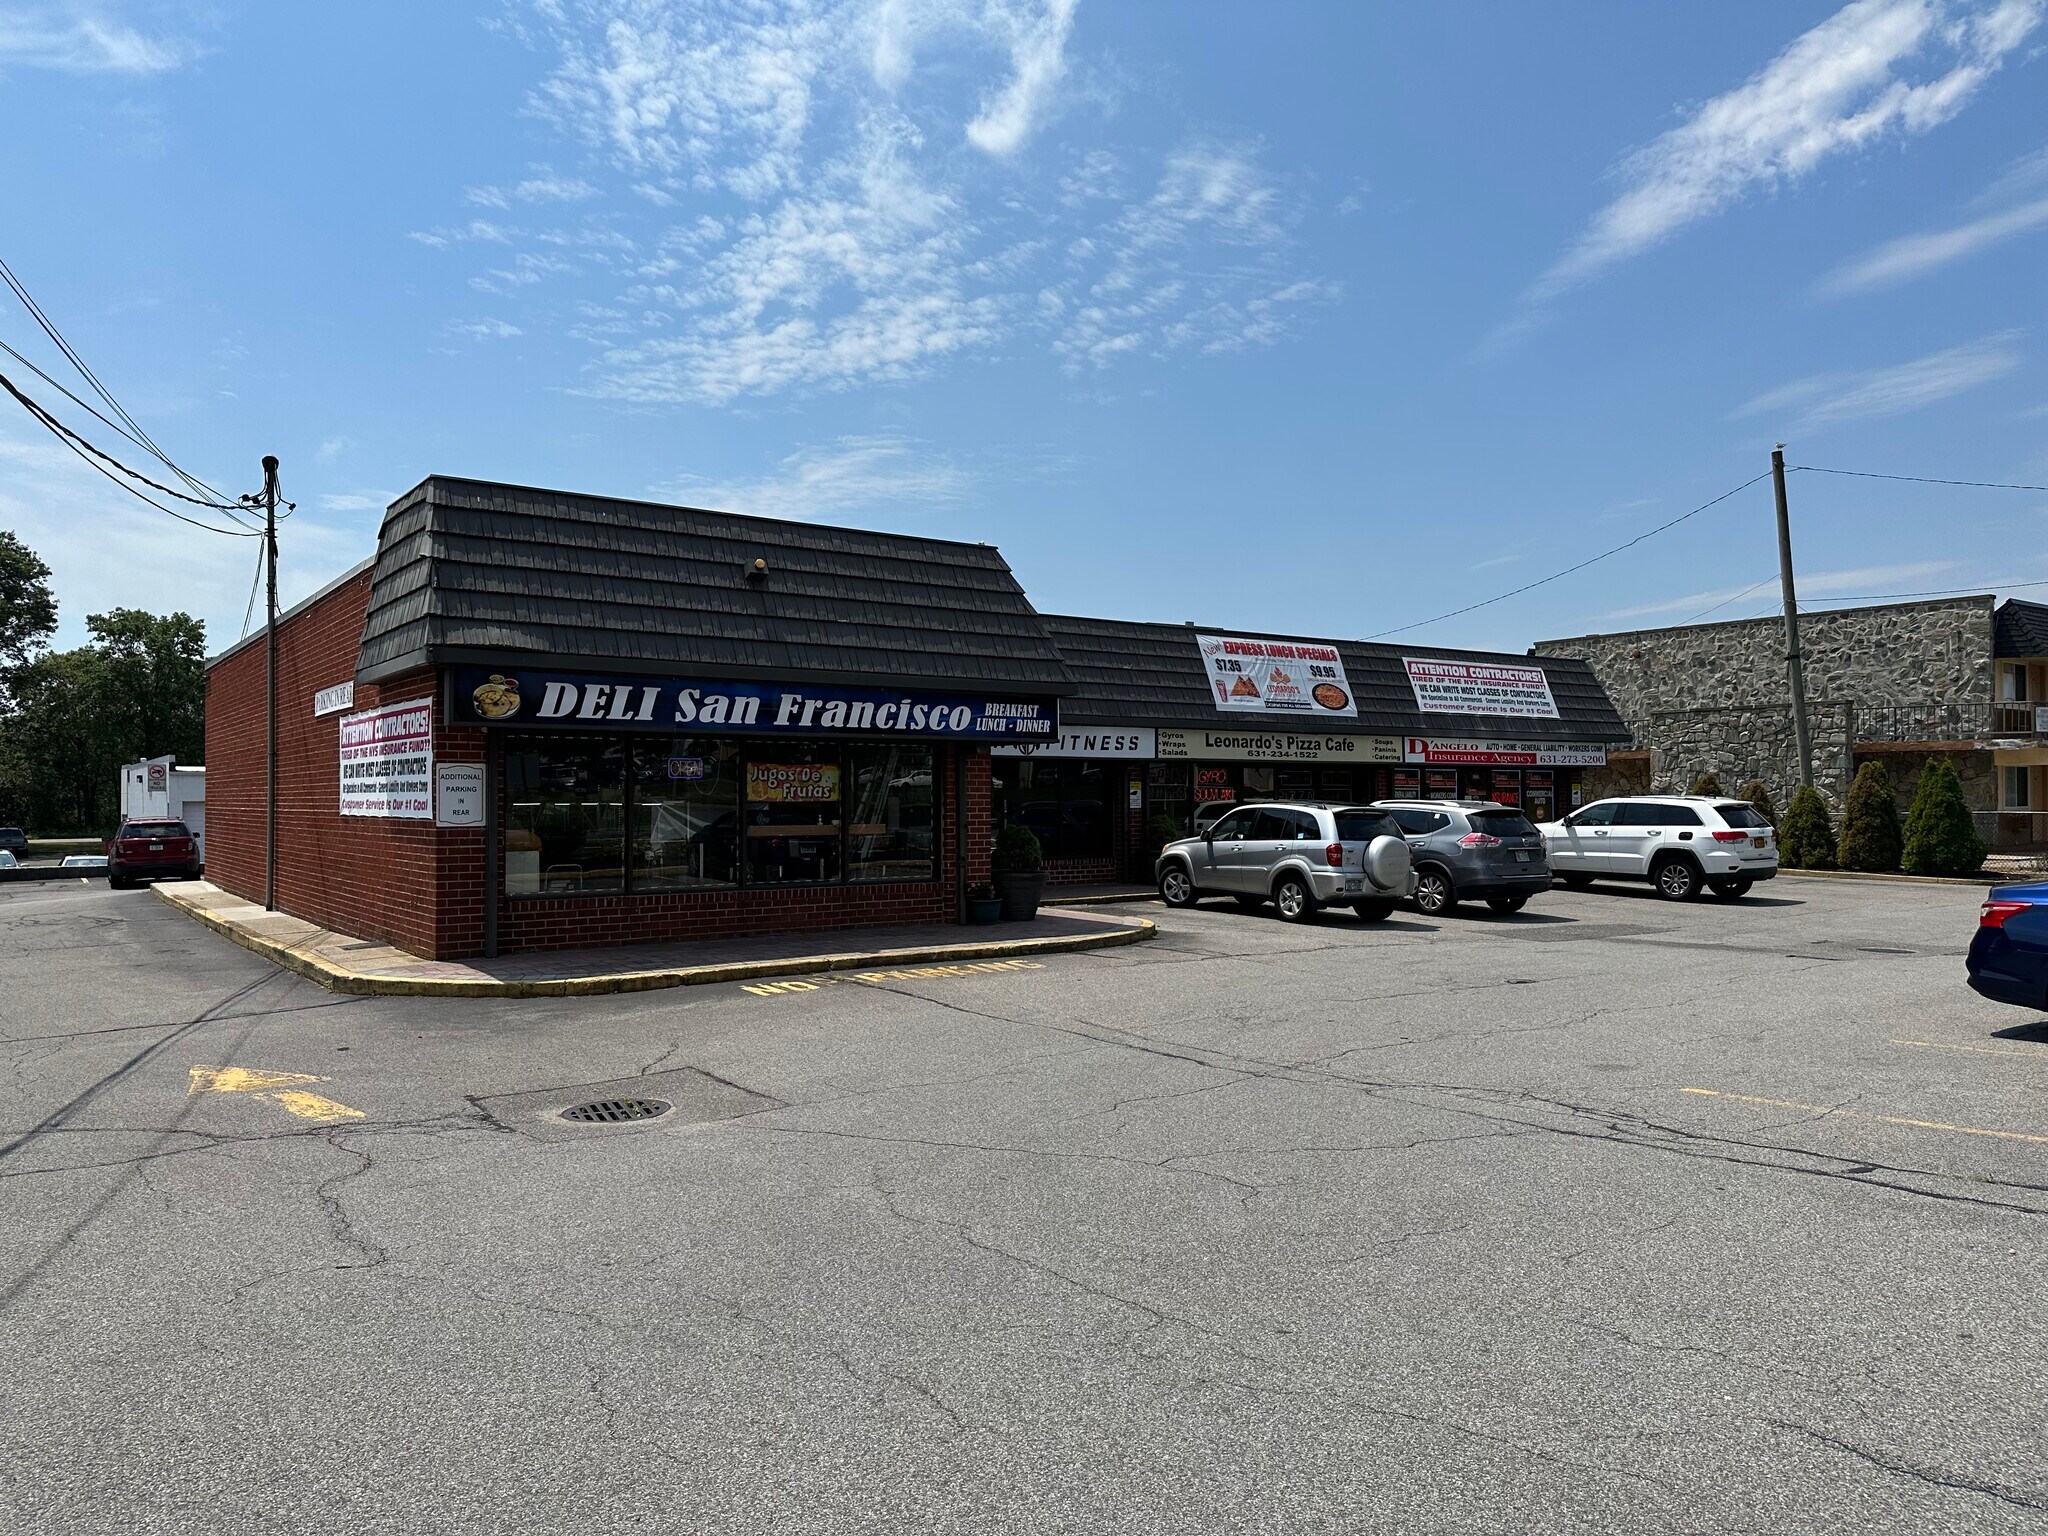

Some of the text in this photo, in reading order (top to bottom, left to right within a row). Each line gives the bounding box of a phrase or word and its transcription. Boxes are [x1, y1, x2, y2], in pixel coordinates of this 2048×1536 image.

[1203, 639, 1221, 658] New!
[1223, 641, 1338, 662] EXPRESS LUNCH SPECIALS
[1215, 658, 1242, 672] $7.35
[1310, 664, 1336, 678] $9.95
[1410, 663, 1542, 682] ATTENTION CONTRACTORS!
[1266, 685, 1300, 694] LEONARDO'S
[1418, 684, 1546, 699] WE CAN WRITE MOST CLASSES OF CONTRACTORS
[1480, 680, 1520, 688] INSURANCE
[536, 682, 971, 731] DELI San Francisco
[985, 702, 1040, 718] BREAKFAST
[342, 710, 429, 744] ATTENTION CONTRACTORS!
[975, 718, 1006, 732] LUNCH
[1016, 718, 1050, 733] DINNER
[1162, 732, 1184, 740] Gyros
[1205, 732, 1354, 752] Leonardo's Pizza Cafe
[342, 738, 430, 760] TIRED OF THE NYS INSURANCE FUND??
[1162, 740, 1186, 748] Wraps
[1408, 738, 1478, 754] D'ANGELO
[1248, 750, 1318, 758] 631-234-1522
[1430, 751, 1534, 764] Insurance Agency
[1540, 754, 1604, 764] 631-273-5200
[355, 762, 365, 778] WRITE
[366, 762, 374, 778] MOST
[375, 760, 390, 777] CLASSES
[391, 760, 396, 776] OF
[398, 757, 427, 776] CONTRACTORS
[671, 760, 701, 776] OPEN
[751, 766, 820, 788] Jugos De
[1198, 770, 1226, 784] GYRO
[782, 783, 831, 798] Frutas
[1526, 790, 1552, 798] COMMERCIAL
[342, 798, 428, 811] Customer Service Is Our #1 Goal
[738, 981, 820, 997] NO
